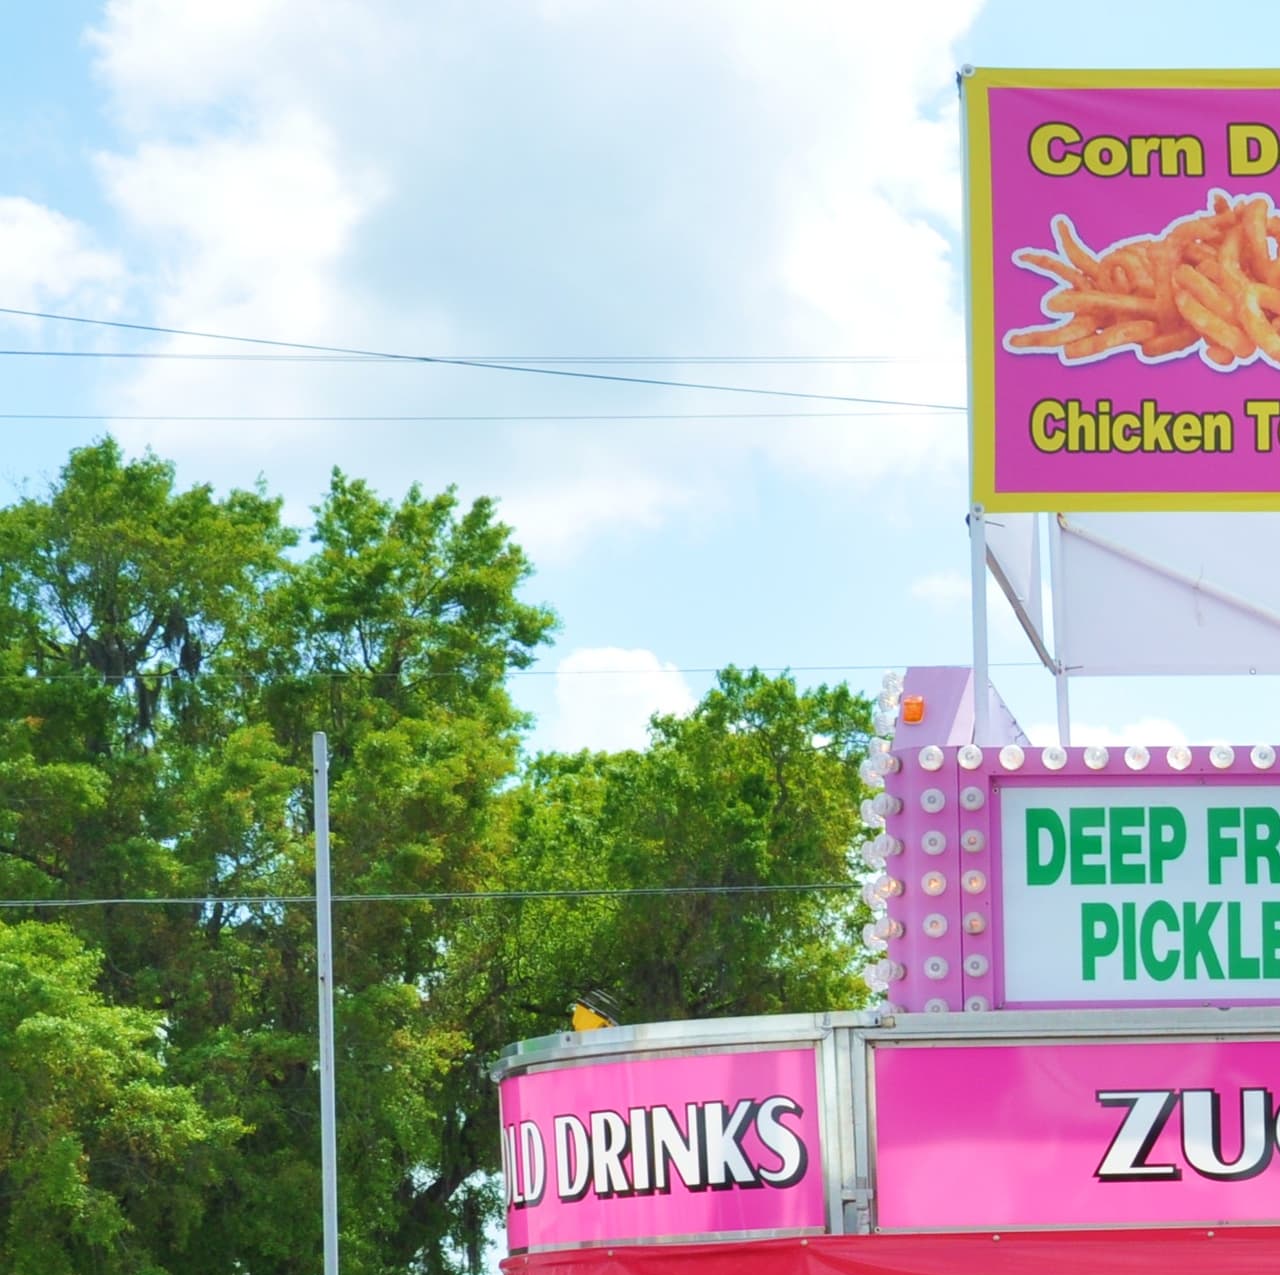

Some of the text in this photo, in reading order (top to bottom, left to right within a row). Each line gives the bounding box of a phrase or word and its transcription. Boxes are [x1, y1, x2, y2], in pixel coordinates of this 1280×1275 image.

[1029, 122, 1203, 176] Corn
[1029, 399, 1234, 453] Chicken
[1025, 805, 1187, 886] DEEP
[554, 1096, 808, 1201] DRINKS
